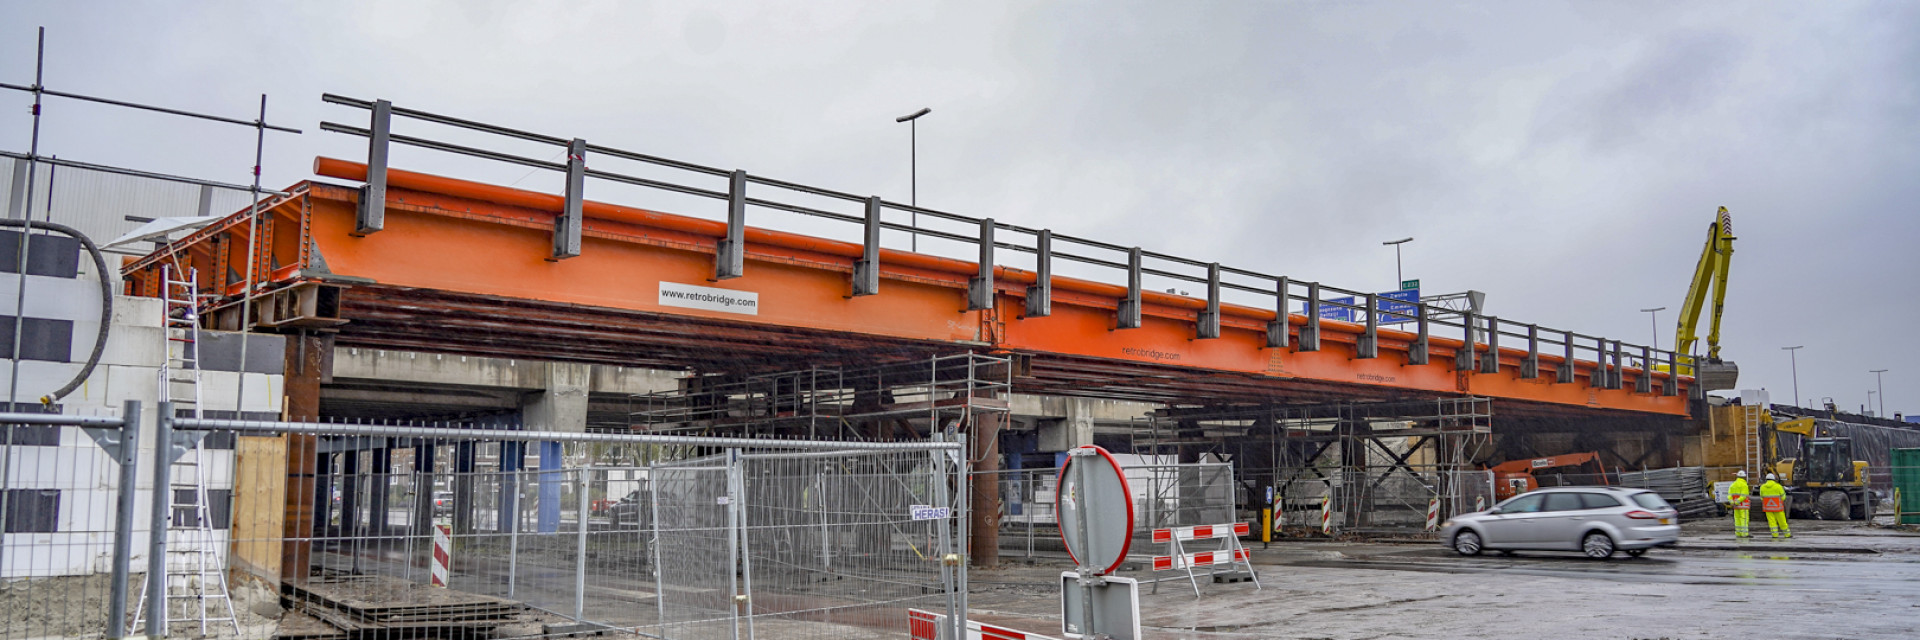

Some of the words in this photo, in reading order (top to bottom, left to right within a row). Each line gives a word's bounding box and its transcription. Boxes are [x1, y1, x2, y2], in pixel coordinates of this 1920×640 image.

[661, 289, 756, 307] www.retrobridge.com
[1122, 347, 1180, 360] retrobridge.com
[1356, 373, 1396, 383] retrobridge.com
